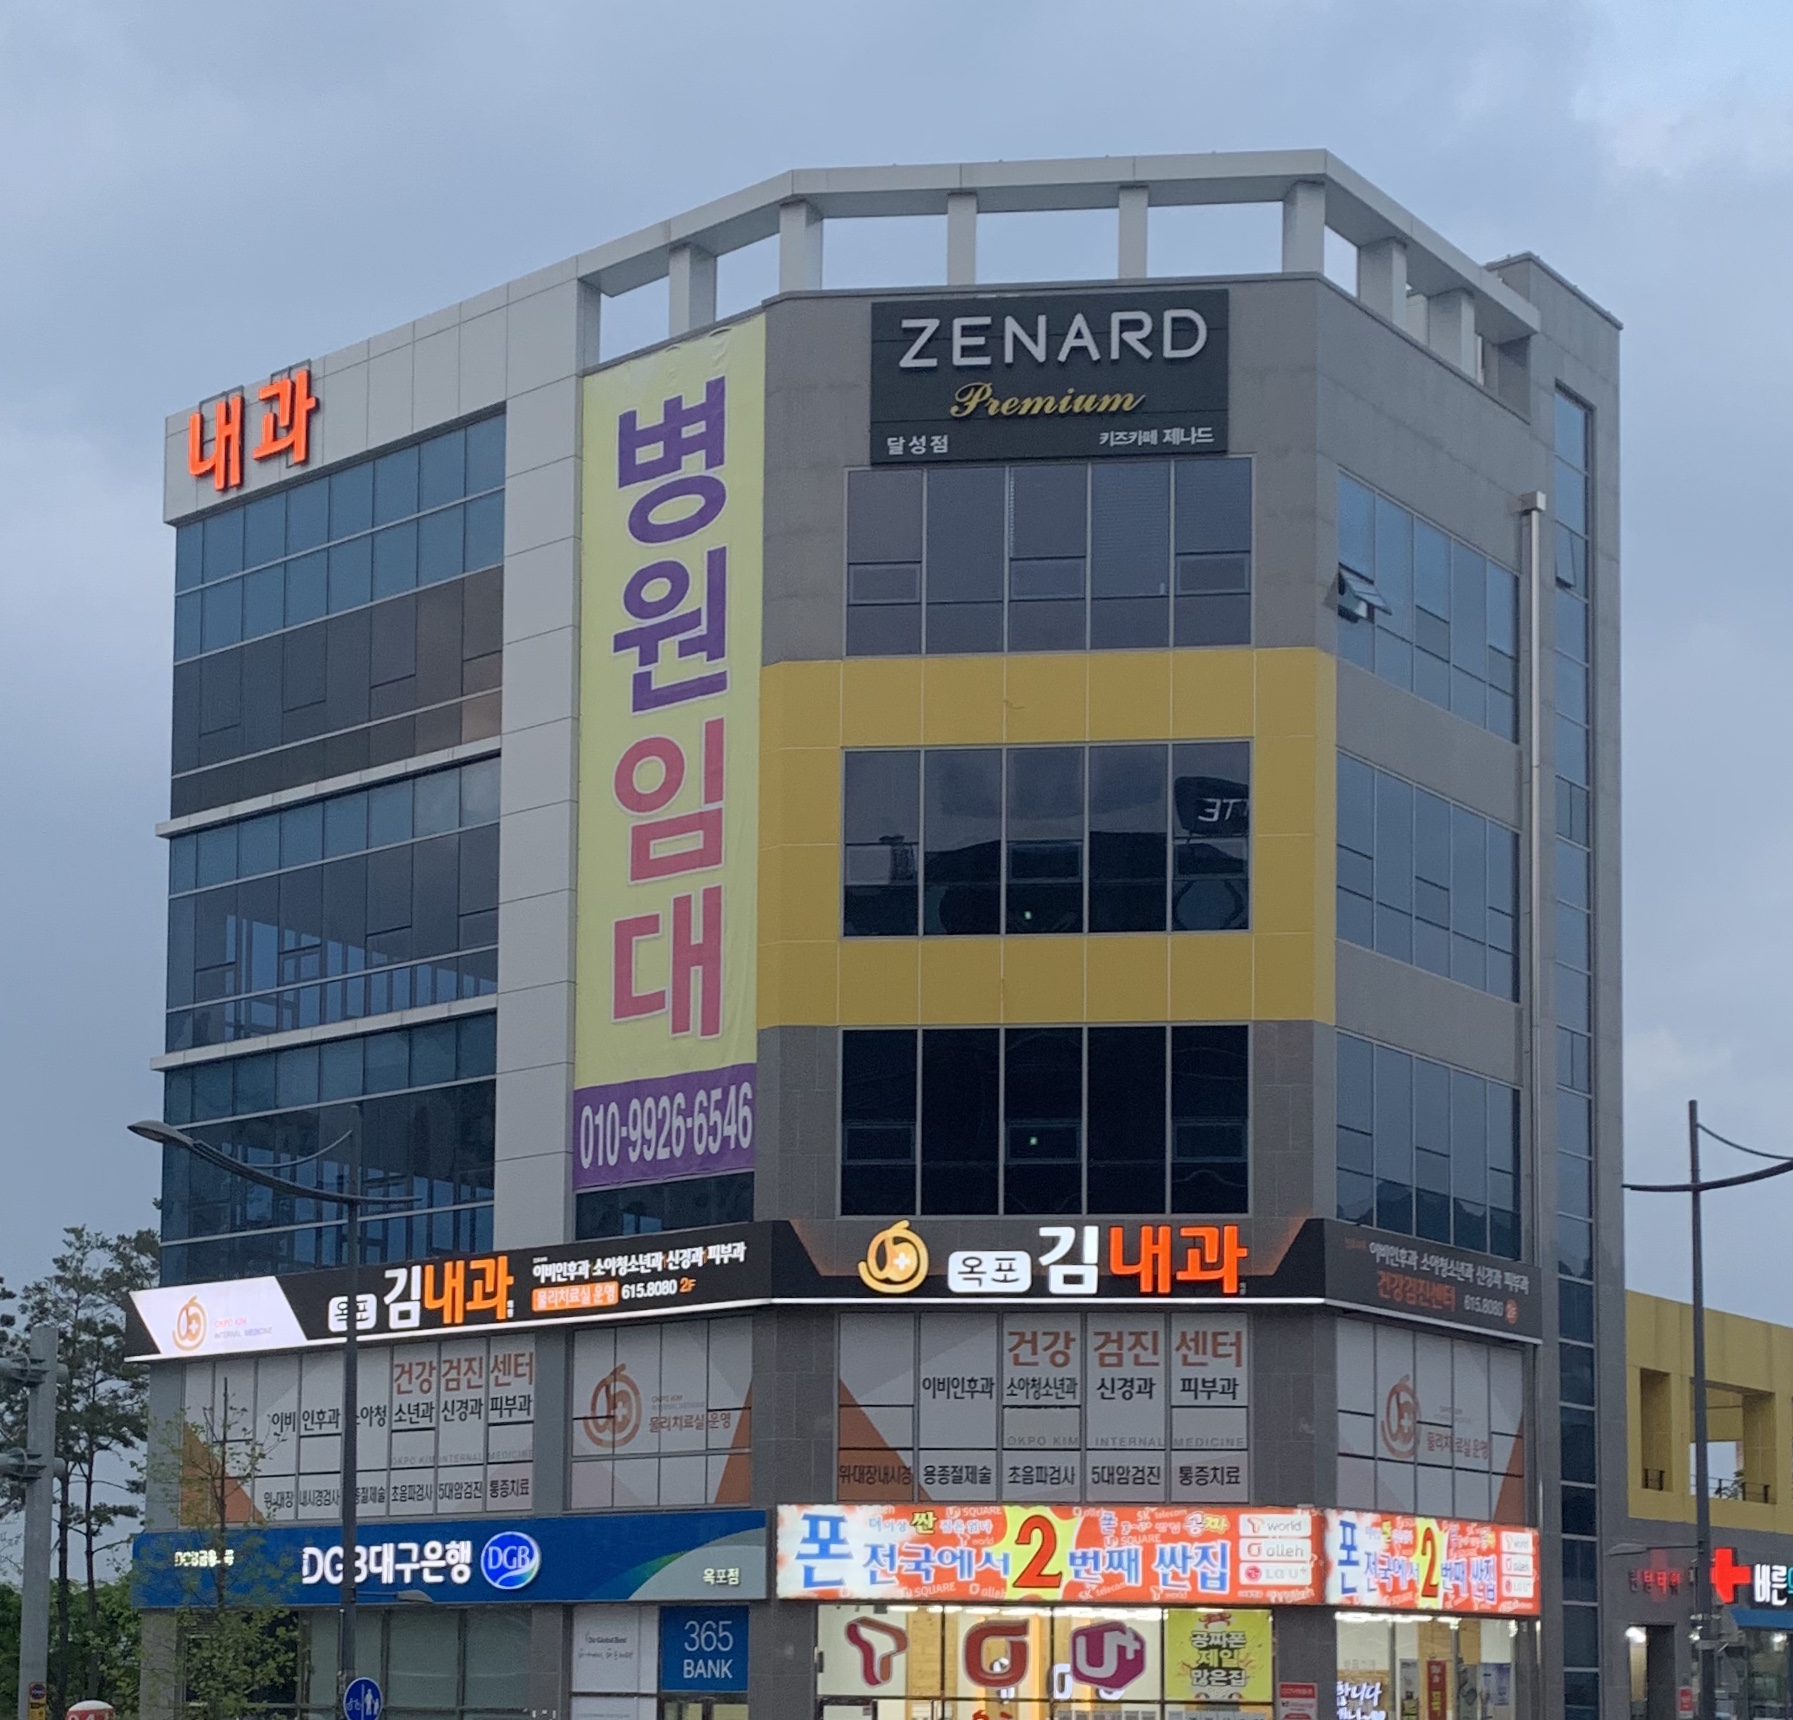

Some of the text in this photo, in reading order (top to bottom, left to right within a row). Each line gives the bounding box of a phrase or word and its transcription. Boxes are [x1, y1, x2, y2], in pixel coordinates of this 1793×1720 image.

[899, 308, 1207, 368] ZENARD
[950, 382, 1146, 417] Premium
[188, 369, 317, 491] 내과
[1099, 427, 1215, 447] 키즈카페 제나드
[887, 435, 949, 456] 달성점
[580, 1081, 753, 1169] 010-9926-6546
[532, 1242, 747, 1284] 이비인후과 소아청소년과 신경과 피부과
[957, 1255, 1020, 1287] 옥포
[593, 1283, 616, 1304] 운영
[621, 1277, 696, 1300] 615.8080 2F
[1008, 1330, 1242, 1368] 건강 검진 센터
[394, 1352, 534, 1395] 건강 검진 센터
[922, 1377, 1239, 1400] 이비인후과 소아청소년과 신경과 피부과
[441, 1398, 484, 1422] 신경과
[489, 1394, 533, 1418] 피부과
[708, 1412, 731, 1429] 운영
[1007, 1436, 1245, 1447] OKPO KIM INTERNAL MEDICINE
[923, 1465, 992, 1486] 용종절제술
[1008, 1466, 1075, 1486] 초음파검사
[1092, 1465, 1161, 1486] 5대암검진
[1179, 1465, 1241, 1486] 통증치료
[391, 1483, 432, 1502] 초음파검사
[438, 1481, 482, 1500] 5대암검진
[489, 1478, 529, 1498] 통증치료
[910, 1511, 937, 1534] 싼
[1267, 1519, 1302, 1532] world
[487, 1546, 531, 1571] DGB
[794, 1512, 854, 1588] 폰
[863, 1542, 1012, 1585] 전국에서
[1012, 1515, 1062, 1588] 2
[1068, 1546, 1142, 1585] 번째
[1266, 1544, 1304, 1557] olleh
[1337, 1520, 1359, 1595] 폰
[1364, 1551, 1419, 1592] 전국에서
[1421, 1527, 1438, 1597] 2
[702, 1568, 740, 1585] 옥포점
[683, 1620, 734, 1652] 365
[1190, 1631, 1247, 1649] 공짜폰
[683, 1659, 733, 1679] BANK
[1198, 1649, 1240, 1667] 제일
[1190, 1669, 1247, 1687] 많은집
